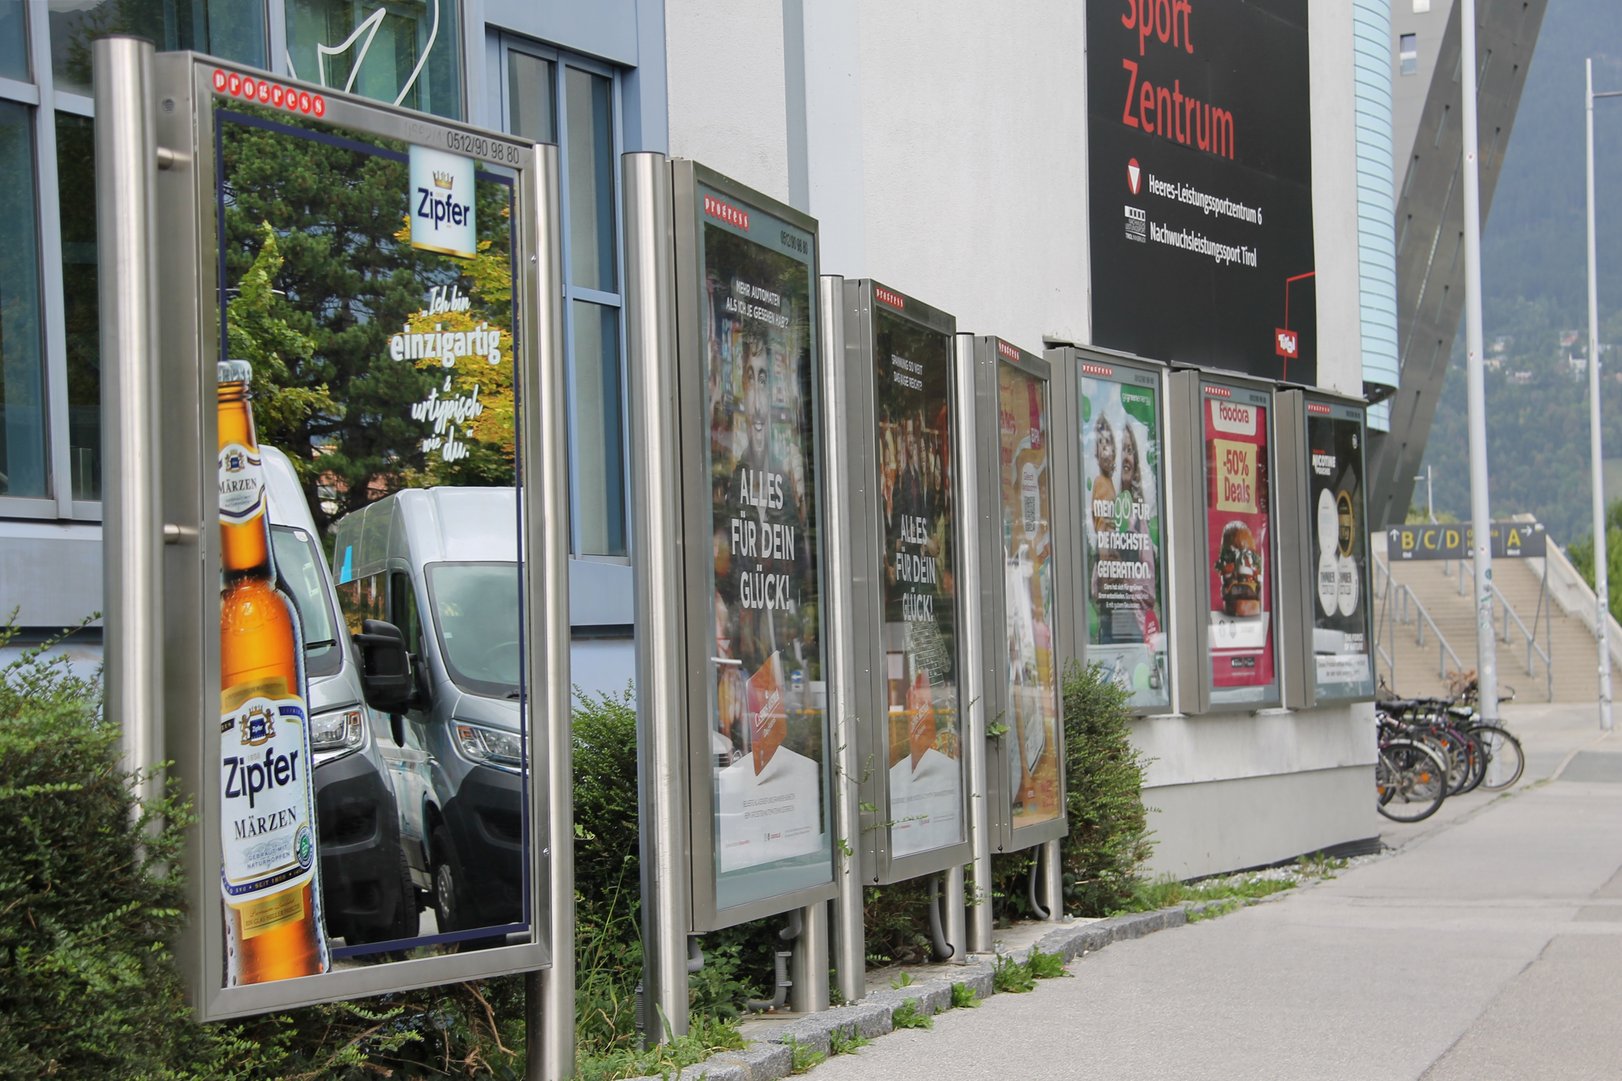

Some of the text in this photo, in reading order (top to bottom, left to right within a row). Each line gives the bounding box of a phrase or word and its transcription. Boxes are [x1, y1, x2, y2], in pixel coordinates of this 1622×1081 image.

[213, 69, 325, 117] progress
[1122, 58, 1234, 160] Zentrum
[446, 130, 488, 157] 0512/90
[491, 141, 504, 160] 98
[507, 145, 520, 164] 80
[417, 187, 470, 230] Zipfer
[704, 194, 749, 232] progress
[1149, 174, 1263, 225] Heeres-Leistungssportzentrum 6
[1150, 221, 1241, 265] Nachwuchsleistungssport
[1241, 246, 1257, 267] Tirol
[450, 285, 471, 312] bin
[726, 297, 738, 312] ALS
[752, 285, 781, 306] AUTOMATEN
[390, 322, 501, 368] einzigartig
[443, 375, 451, 392] &
[411, 384, 484, 434] urtypisch
[1220, 402, 1249, 424] foodora
[1223, 449, 1249, 477] -50%
[740, 468, 784, 510] ALLES
[1224, 477, 1250, 503] Deals
[731, 510, 795, 561] FÜR DEIN
[900, 513, 928, 545] ALLES
[1507, 528, 1521, 547] A
[895, 546, 936, 584] FÜR DEIN
[740, 564, 790, 610] GLÜCK!
[902, 586, 934, 622] GLÜCK!
[223, 747, 298, 809] Zipfer
[234, 806, 297, 841] MÄRZEN
